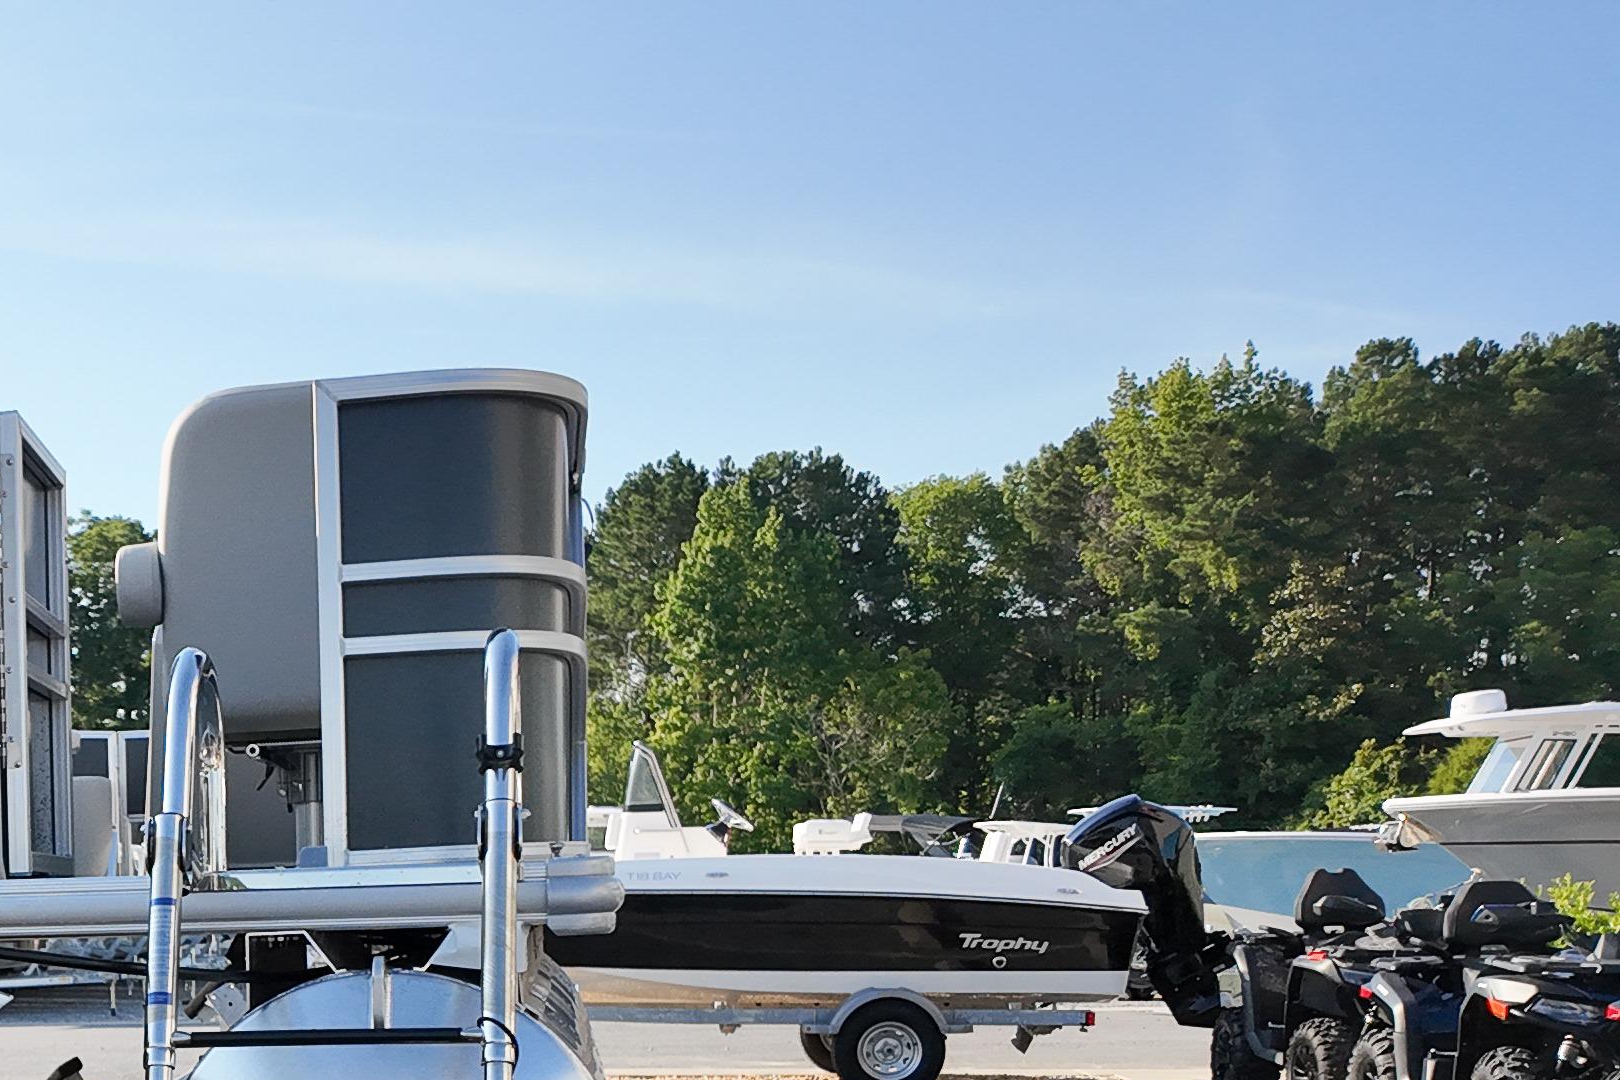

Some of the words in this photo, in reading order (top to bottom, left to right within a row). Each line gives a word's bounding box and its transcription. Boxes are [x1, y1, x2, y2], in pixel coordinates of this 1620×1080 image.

[1077, 822, 1137, 871] MERCURY
[653, 871, 682, 881] BAY
[958, 932, 1050, 954] Trophy
